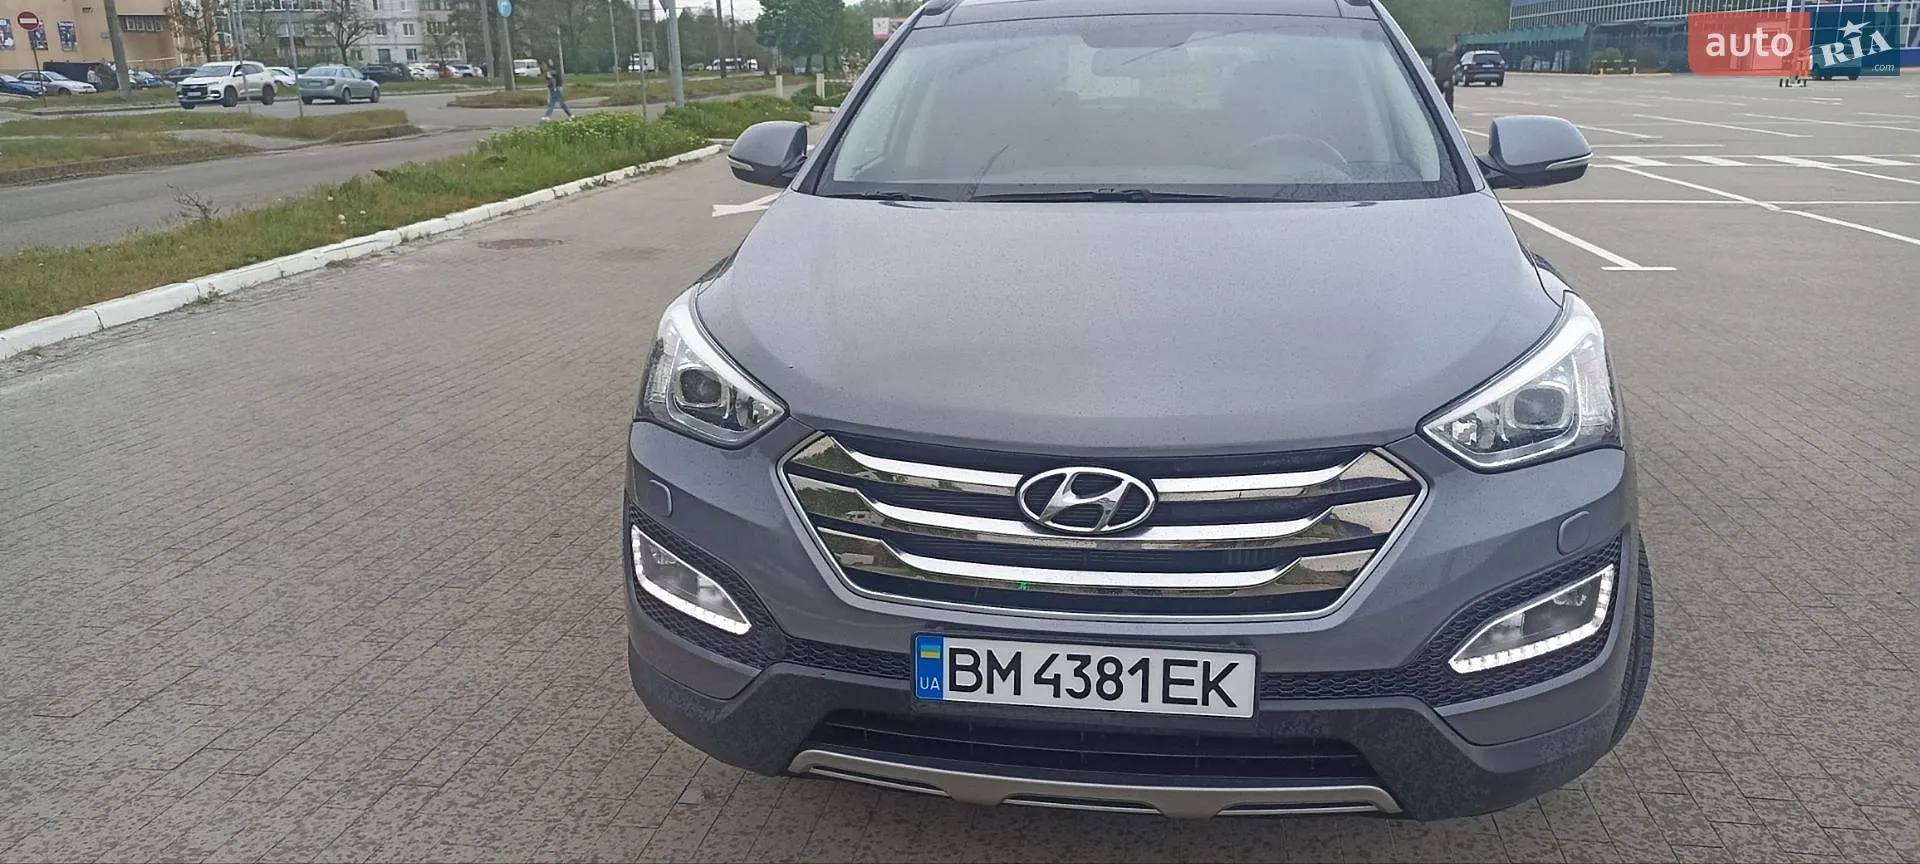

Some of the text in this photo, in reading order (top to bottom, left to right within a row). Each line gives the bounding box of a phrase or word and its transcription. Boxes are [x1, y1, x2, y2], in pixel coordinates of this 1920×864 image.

[919, 677, 941, 691] UA
[949, 647, 1240, 708] BM 4381 EK
